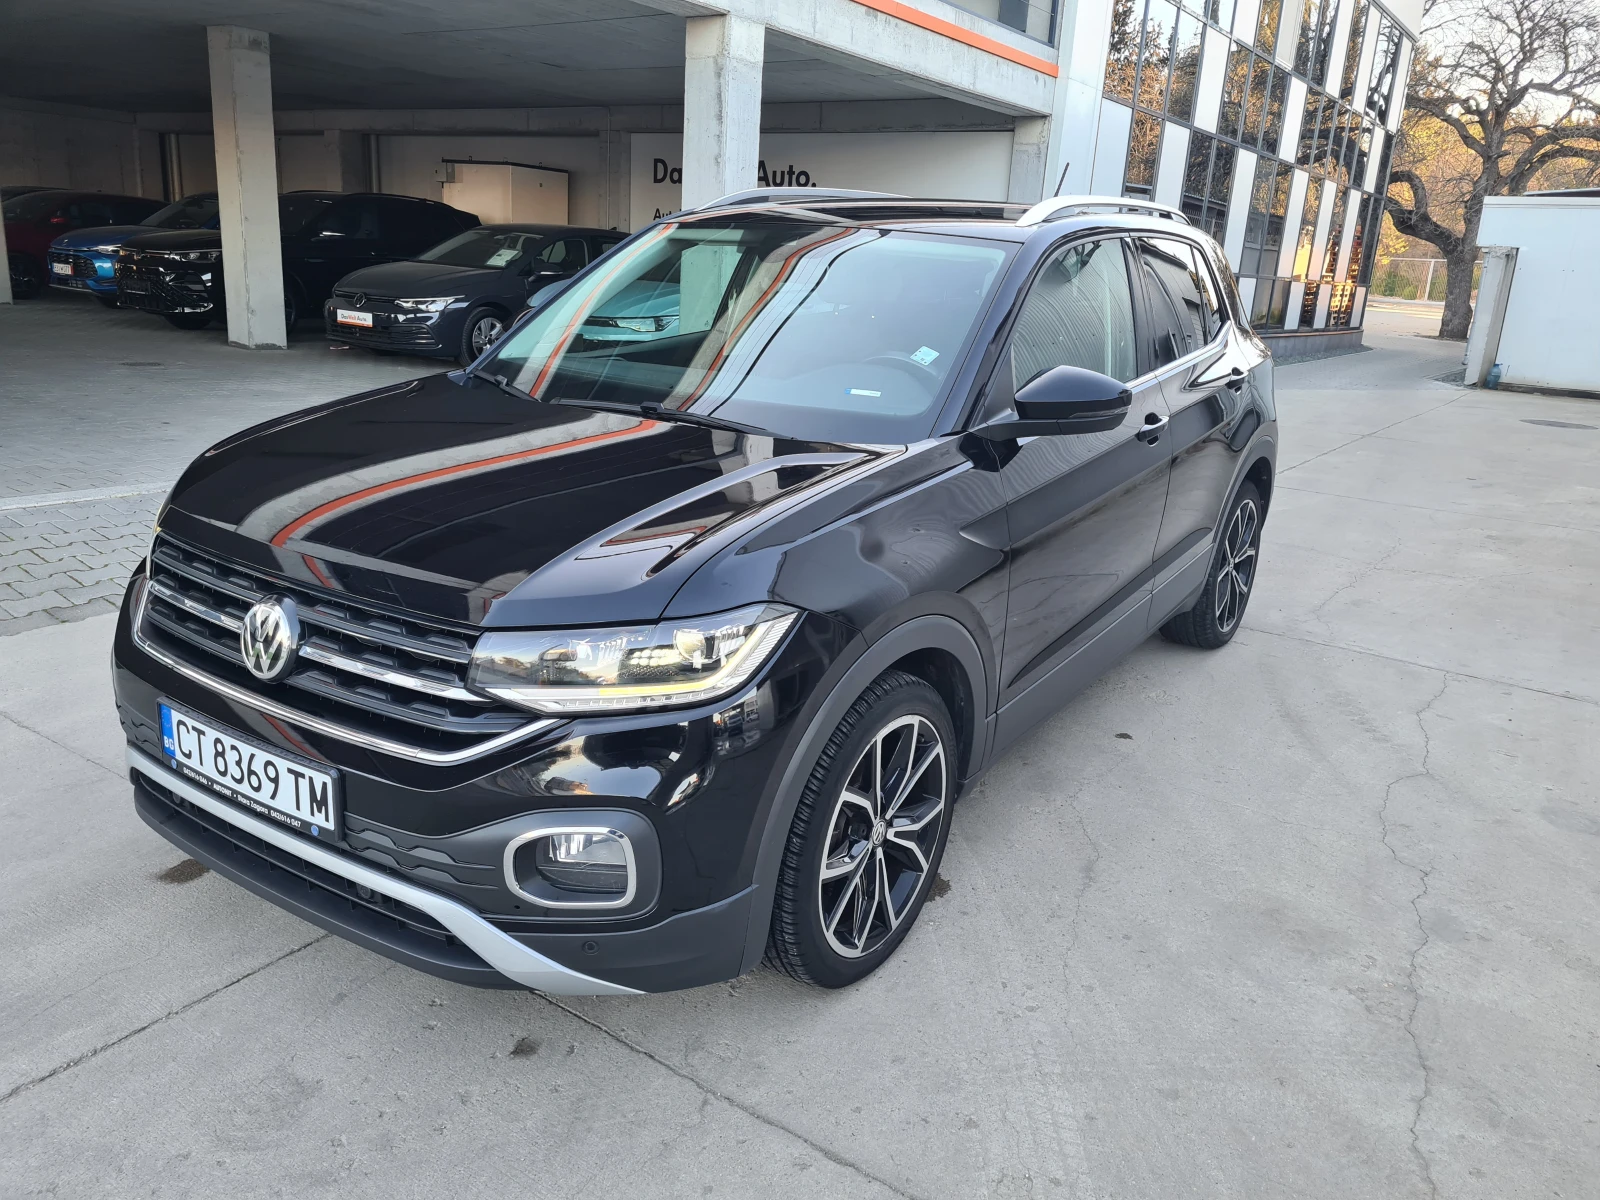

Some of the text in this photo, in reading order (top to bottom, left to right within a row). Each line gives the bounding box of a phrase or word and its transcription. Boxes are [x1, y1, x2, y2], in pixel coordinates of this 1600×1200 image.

[163, 735, 174, 750] BG
[176, 719, 206, 767] CT
[213, 737, 280, 800] 8369
[287, 767, 330, 823] TM
